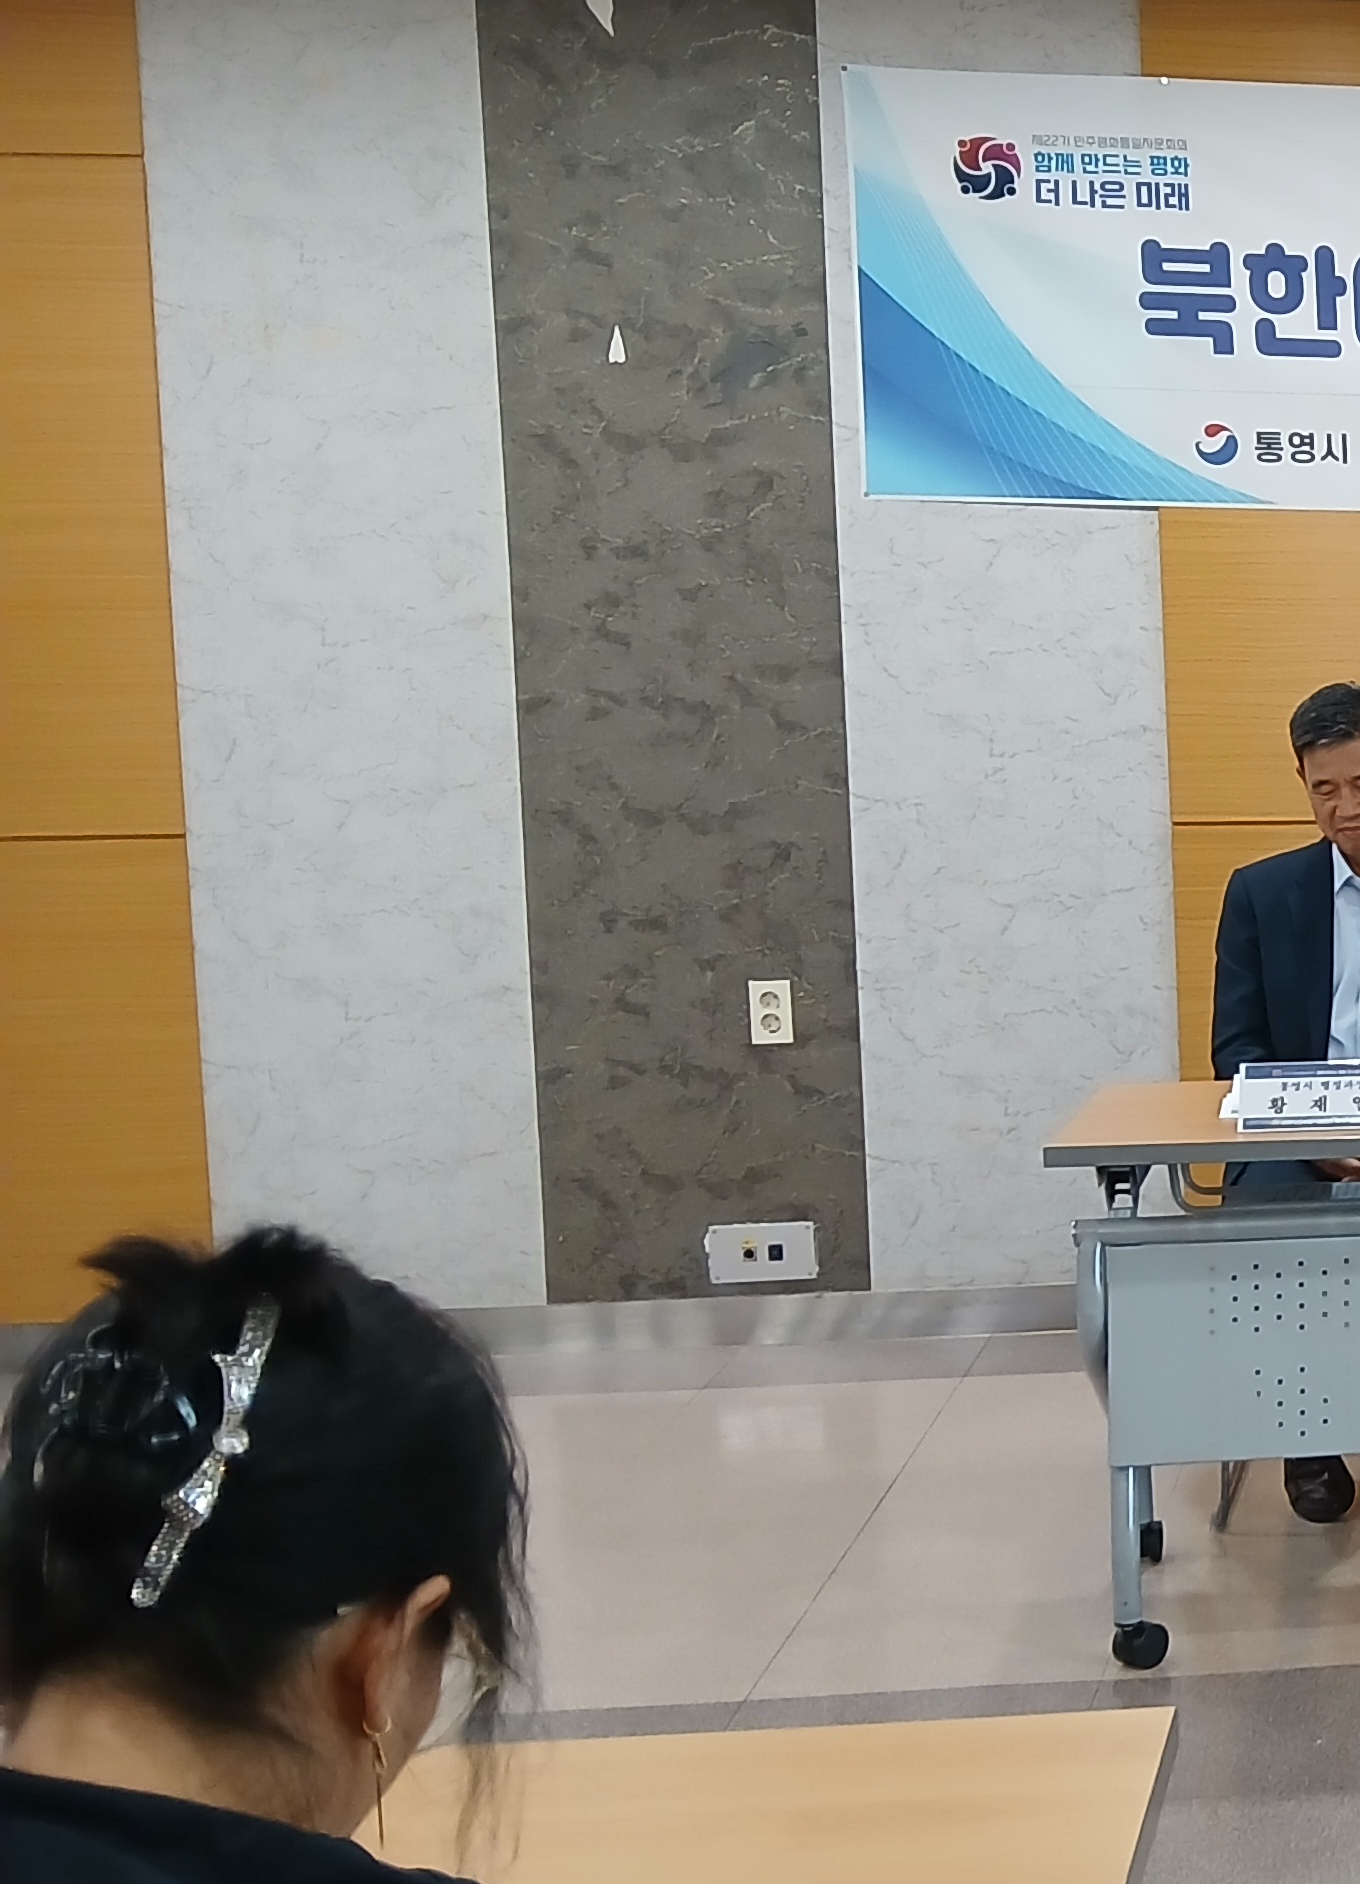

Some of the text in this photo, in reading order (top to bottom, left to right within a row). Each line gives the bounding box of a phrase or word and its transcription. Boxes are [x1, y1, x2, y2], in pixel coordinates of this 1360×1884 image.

[1032, 150, 1190, 178] 함께 만드는 평화
[1034, 178, 1191, 212] 더 나은 미래
[1254, 430, 1348, 465] 통영시
